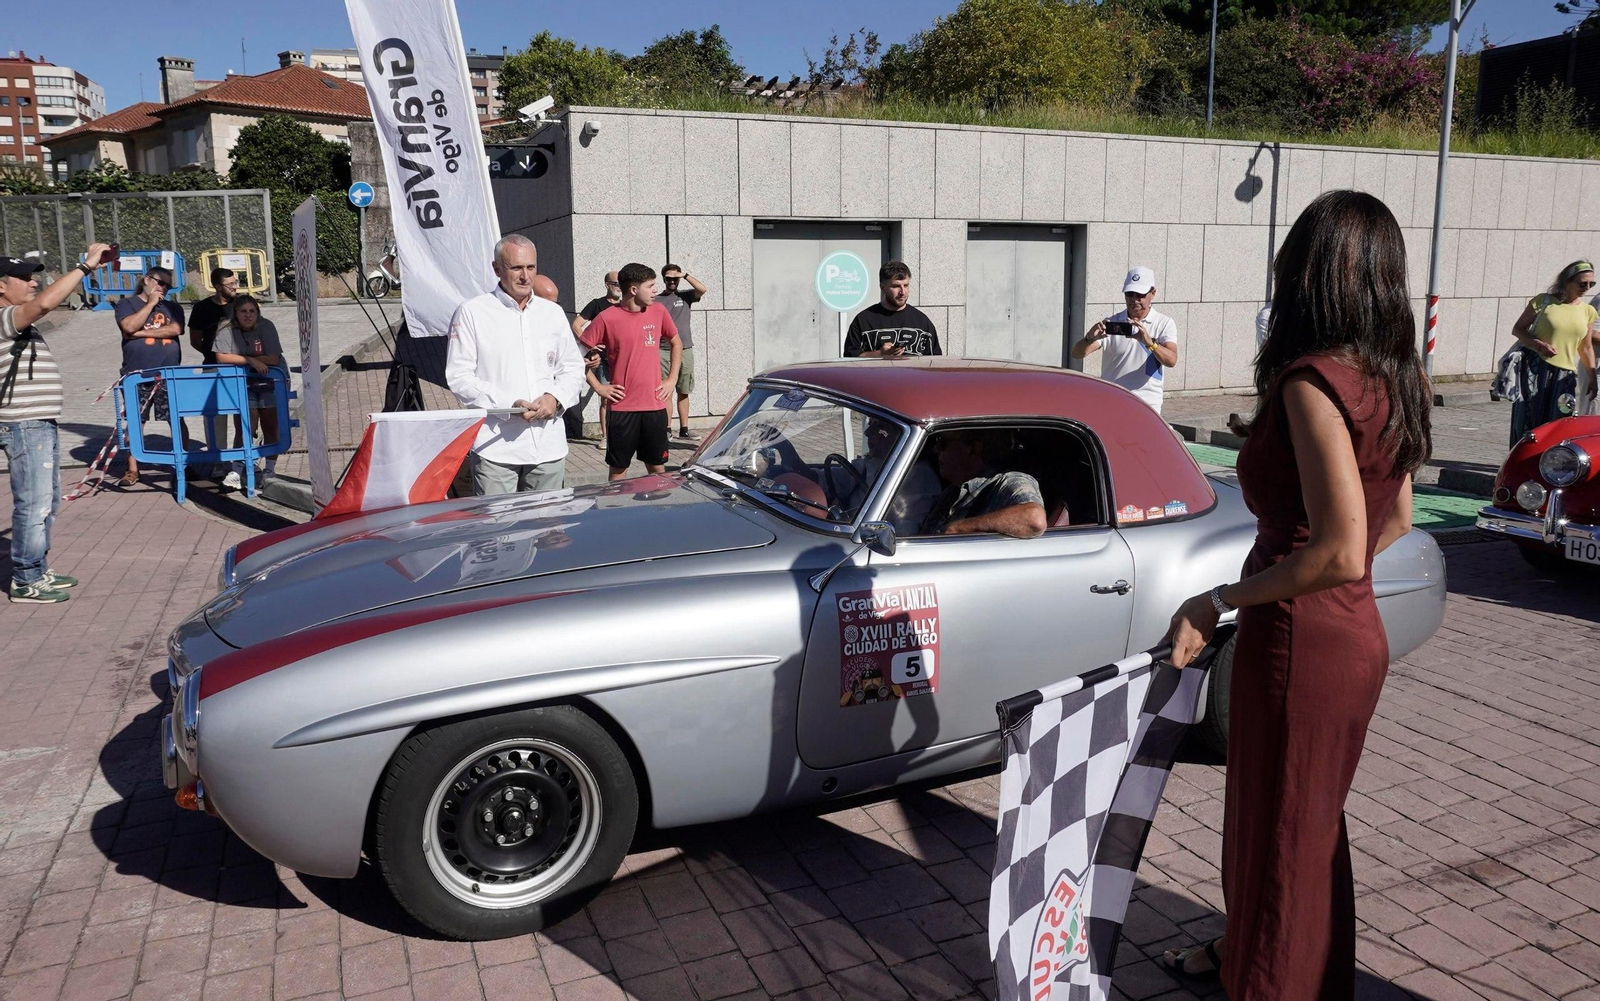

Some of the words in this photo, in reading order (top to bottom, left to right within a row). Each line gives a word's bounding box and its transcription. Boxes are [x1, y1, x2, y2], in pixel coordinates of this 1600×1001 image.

[826, 265, 839, 283] P
[839, 594, 900, 613] GranVía
[901, 586, 937, 611] LANZAL
[858, 611, 868, 620] de
[868, 610, 886, 620] Vigo
[860, 623, 892, 642] XVIII
[896, 617, 937, 637] RALLY
[843, 638, 888, 656] CIUDAD
[892, 636, 907, 650] DE
[911, 633, 938, 647] VIGO
[905, 655, 921, 678] 5
